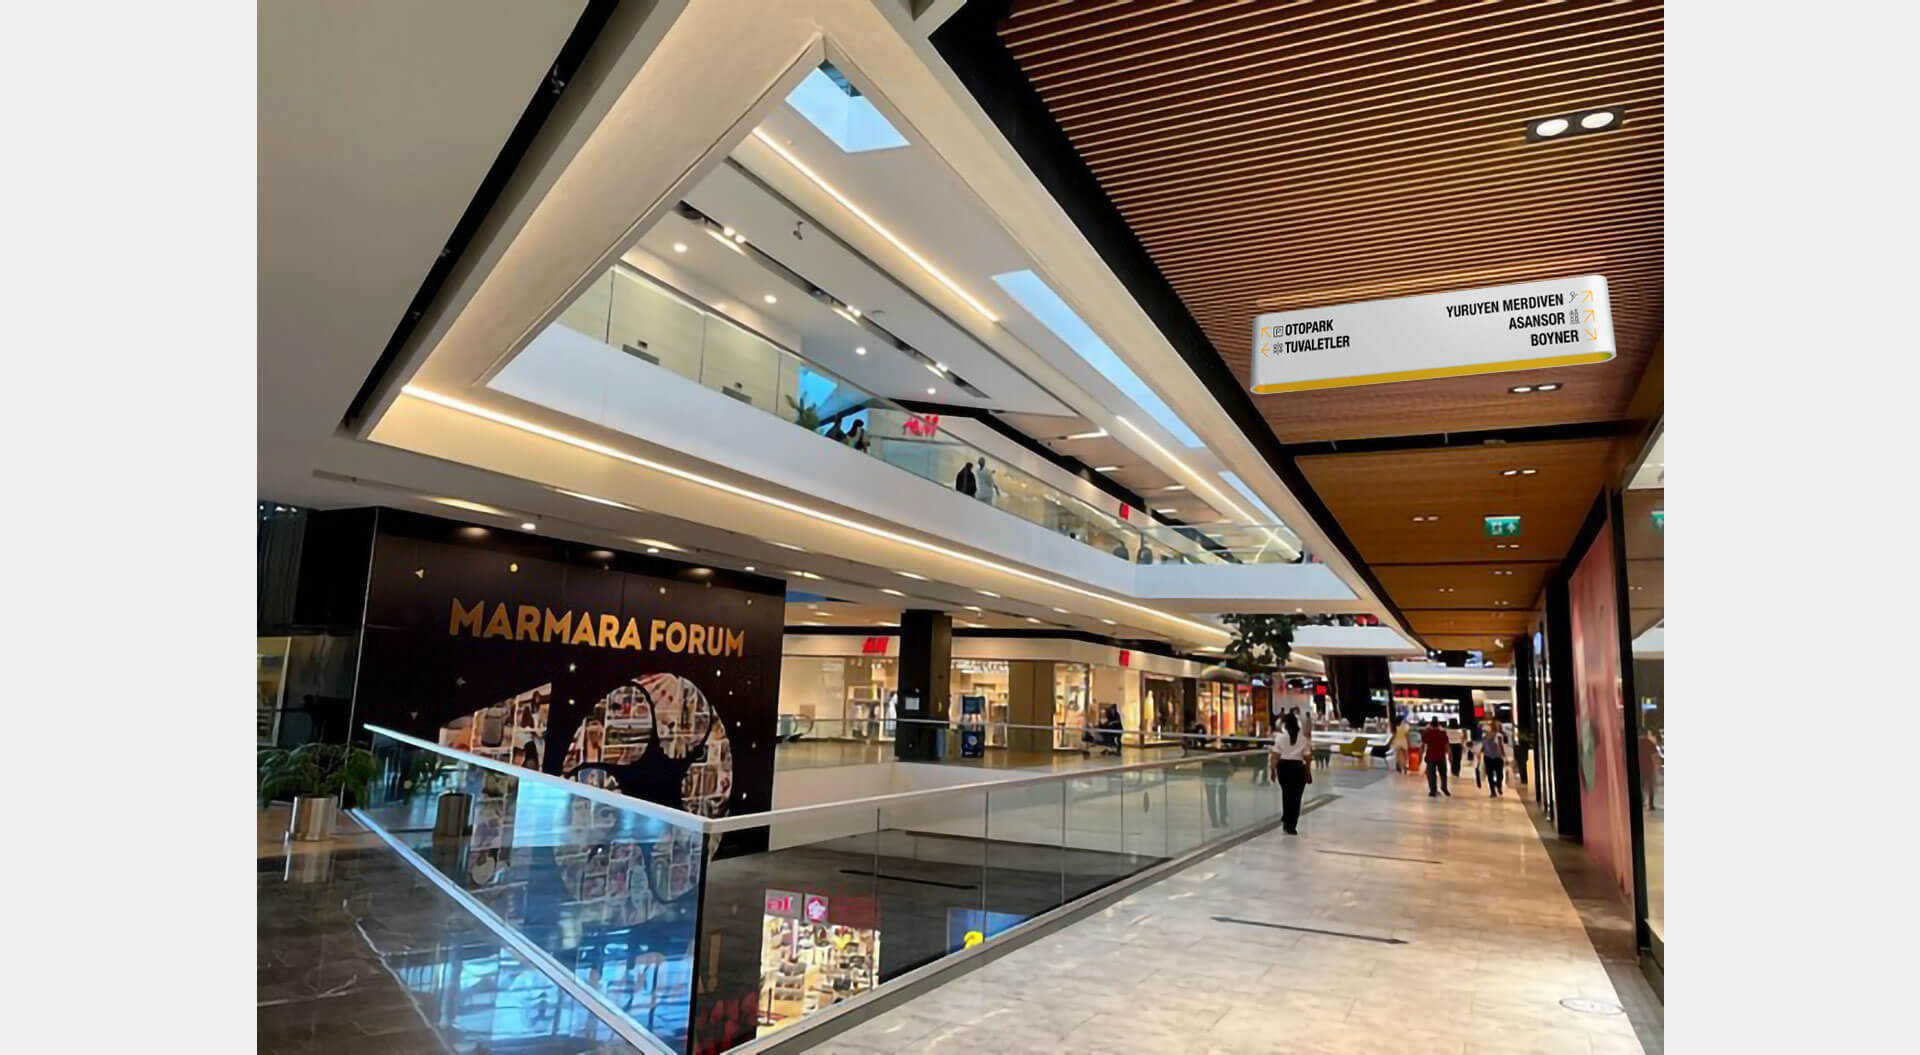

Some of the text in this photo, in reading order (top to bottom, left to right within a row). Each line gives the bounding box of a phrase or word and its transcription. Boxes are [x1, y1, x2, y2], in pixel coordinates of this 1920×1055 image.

[1446, 293, 1564, 318] YURUYEN MERDIVEN
[1285, 319, 1334, 336] OTOPARK
[1508, 312, 1565, 330] ASANSOR
[1285, 335, 1350, 354] TUVALETLER
[1530, 329, 1579, 346] BOYNER
[450, 597, 745, 657] MARMARA FORUM
